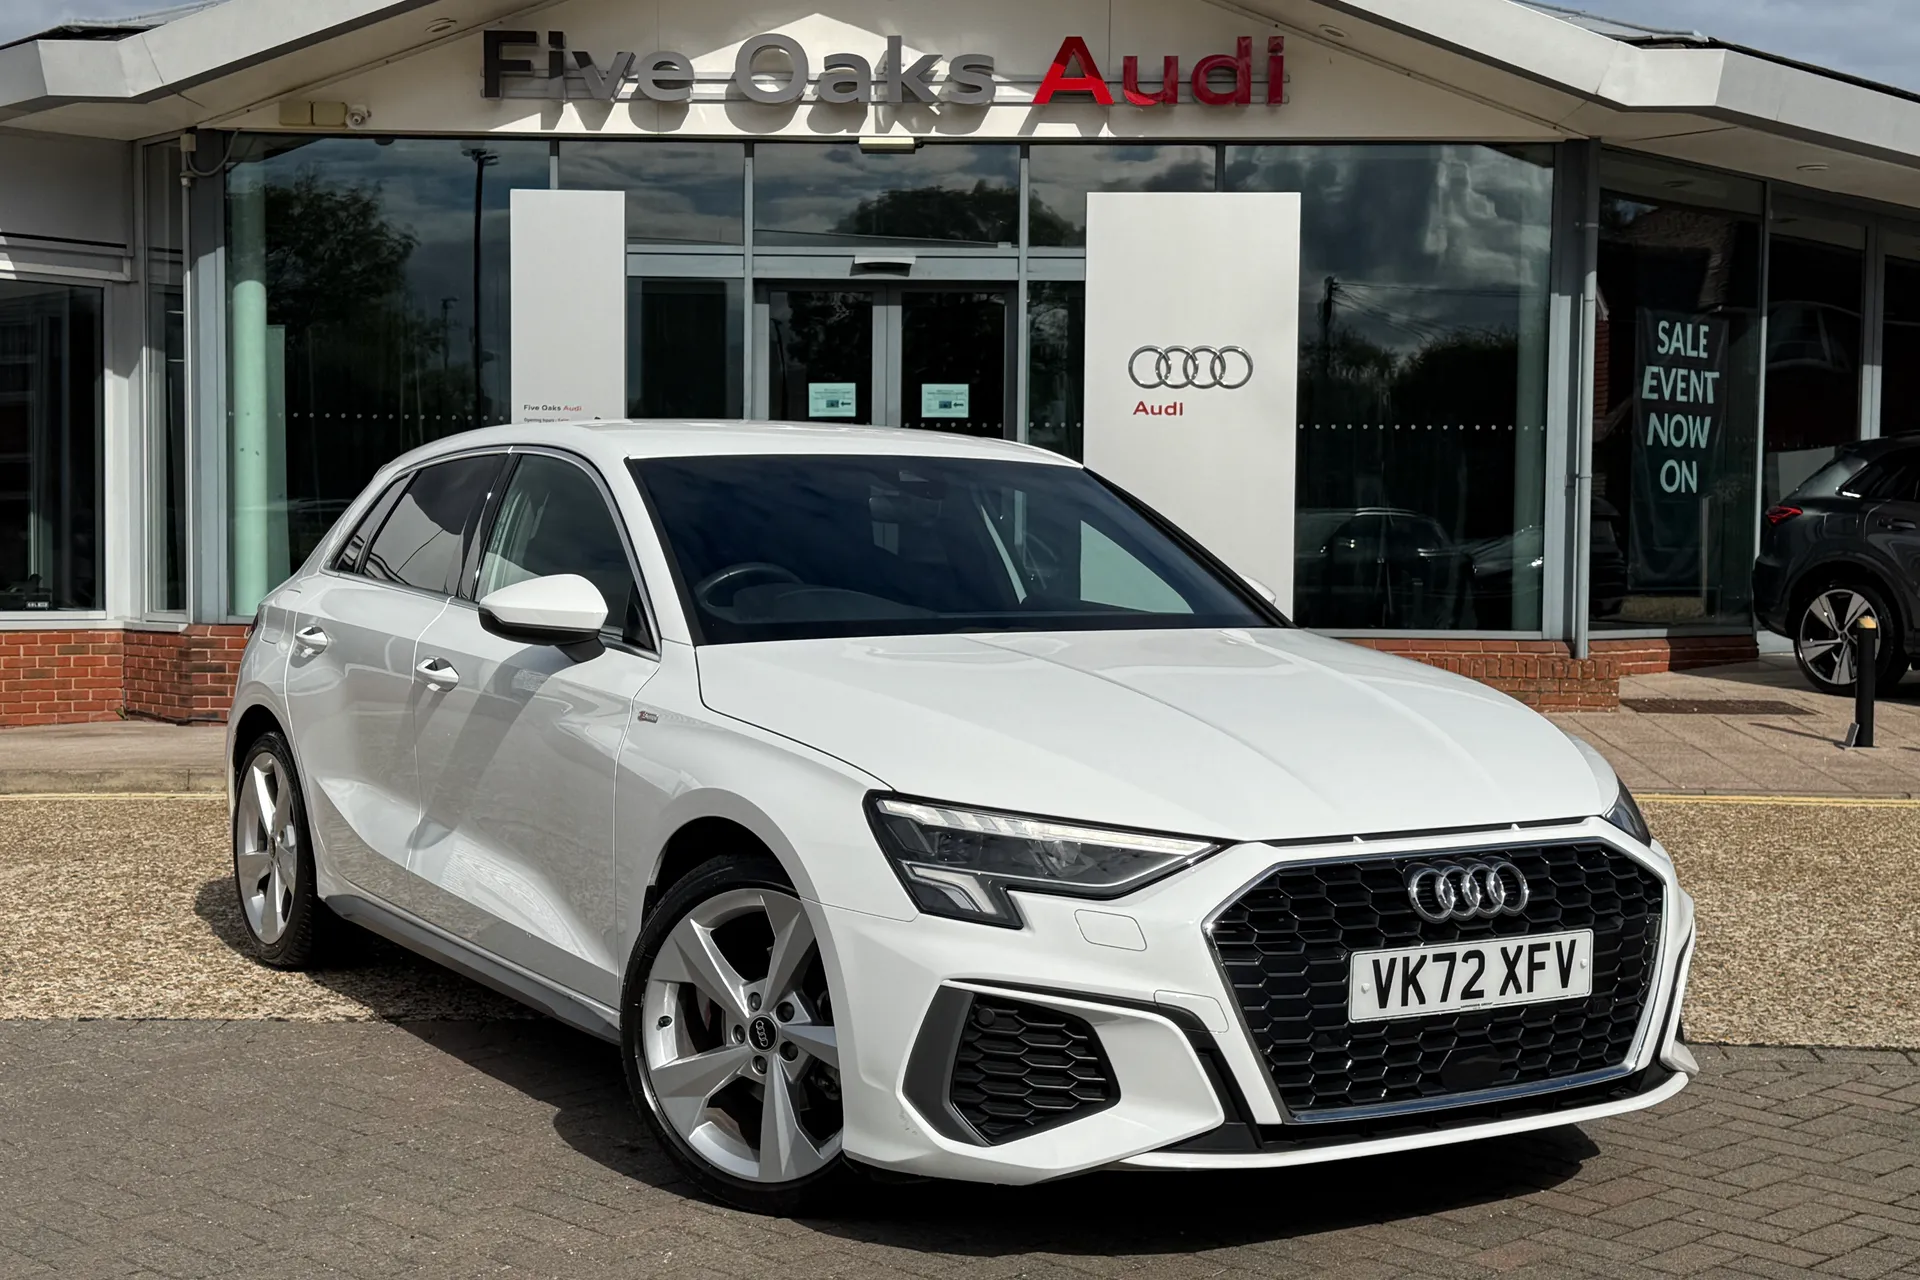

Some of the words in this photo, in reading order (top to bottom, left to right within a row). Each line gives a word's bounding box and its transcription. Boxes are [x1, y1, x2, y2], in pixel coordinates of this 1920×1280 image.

[483, 30, 695, 102] Five
[735, 33, 997, 104] Oaks
[1032, 35, 1285, 107] Audi
[1657, 320, 1709, 359] SALE
[1641, 365, 1720, 405] EVENT
[1133, 401, 1183, 416] Audi
[1646, 412, 1711, 449] NOW
[1659, 459, 1697, 493] ON
[1372, 949, 1486, 1010] VK72
[1498, 938, 1578, 997] XFV
